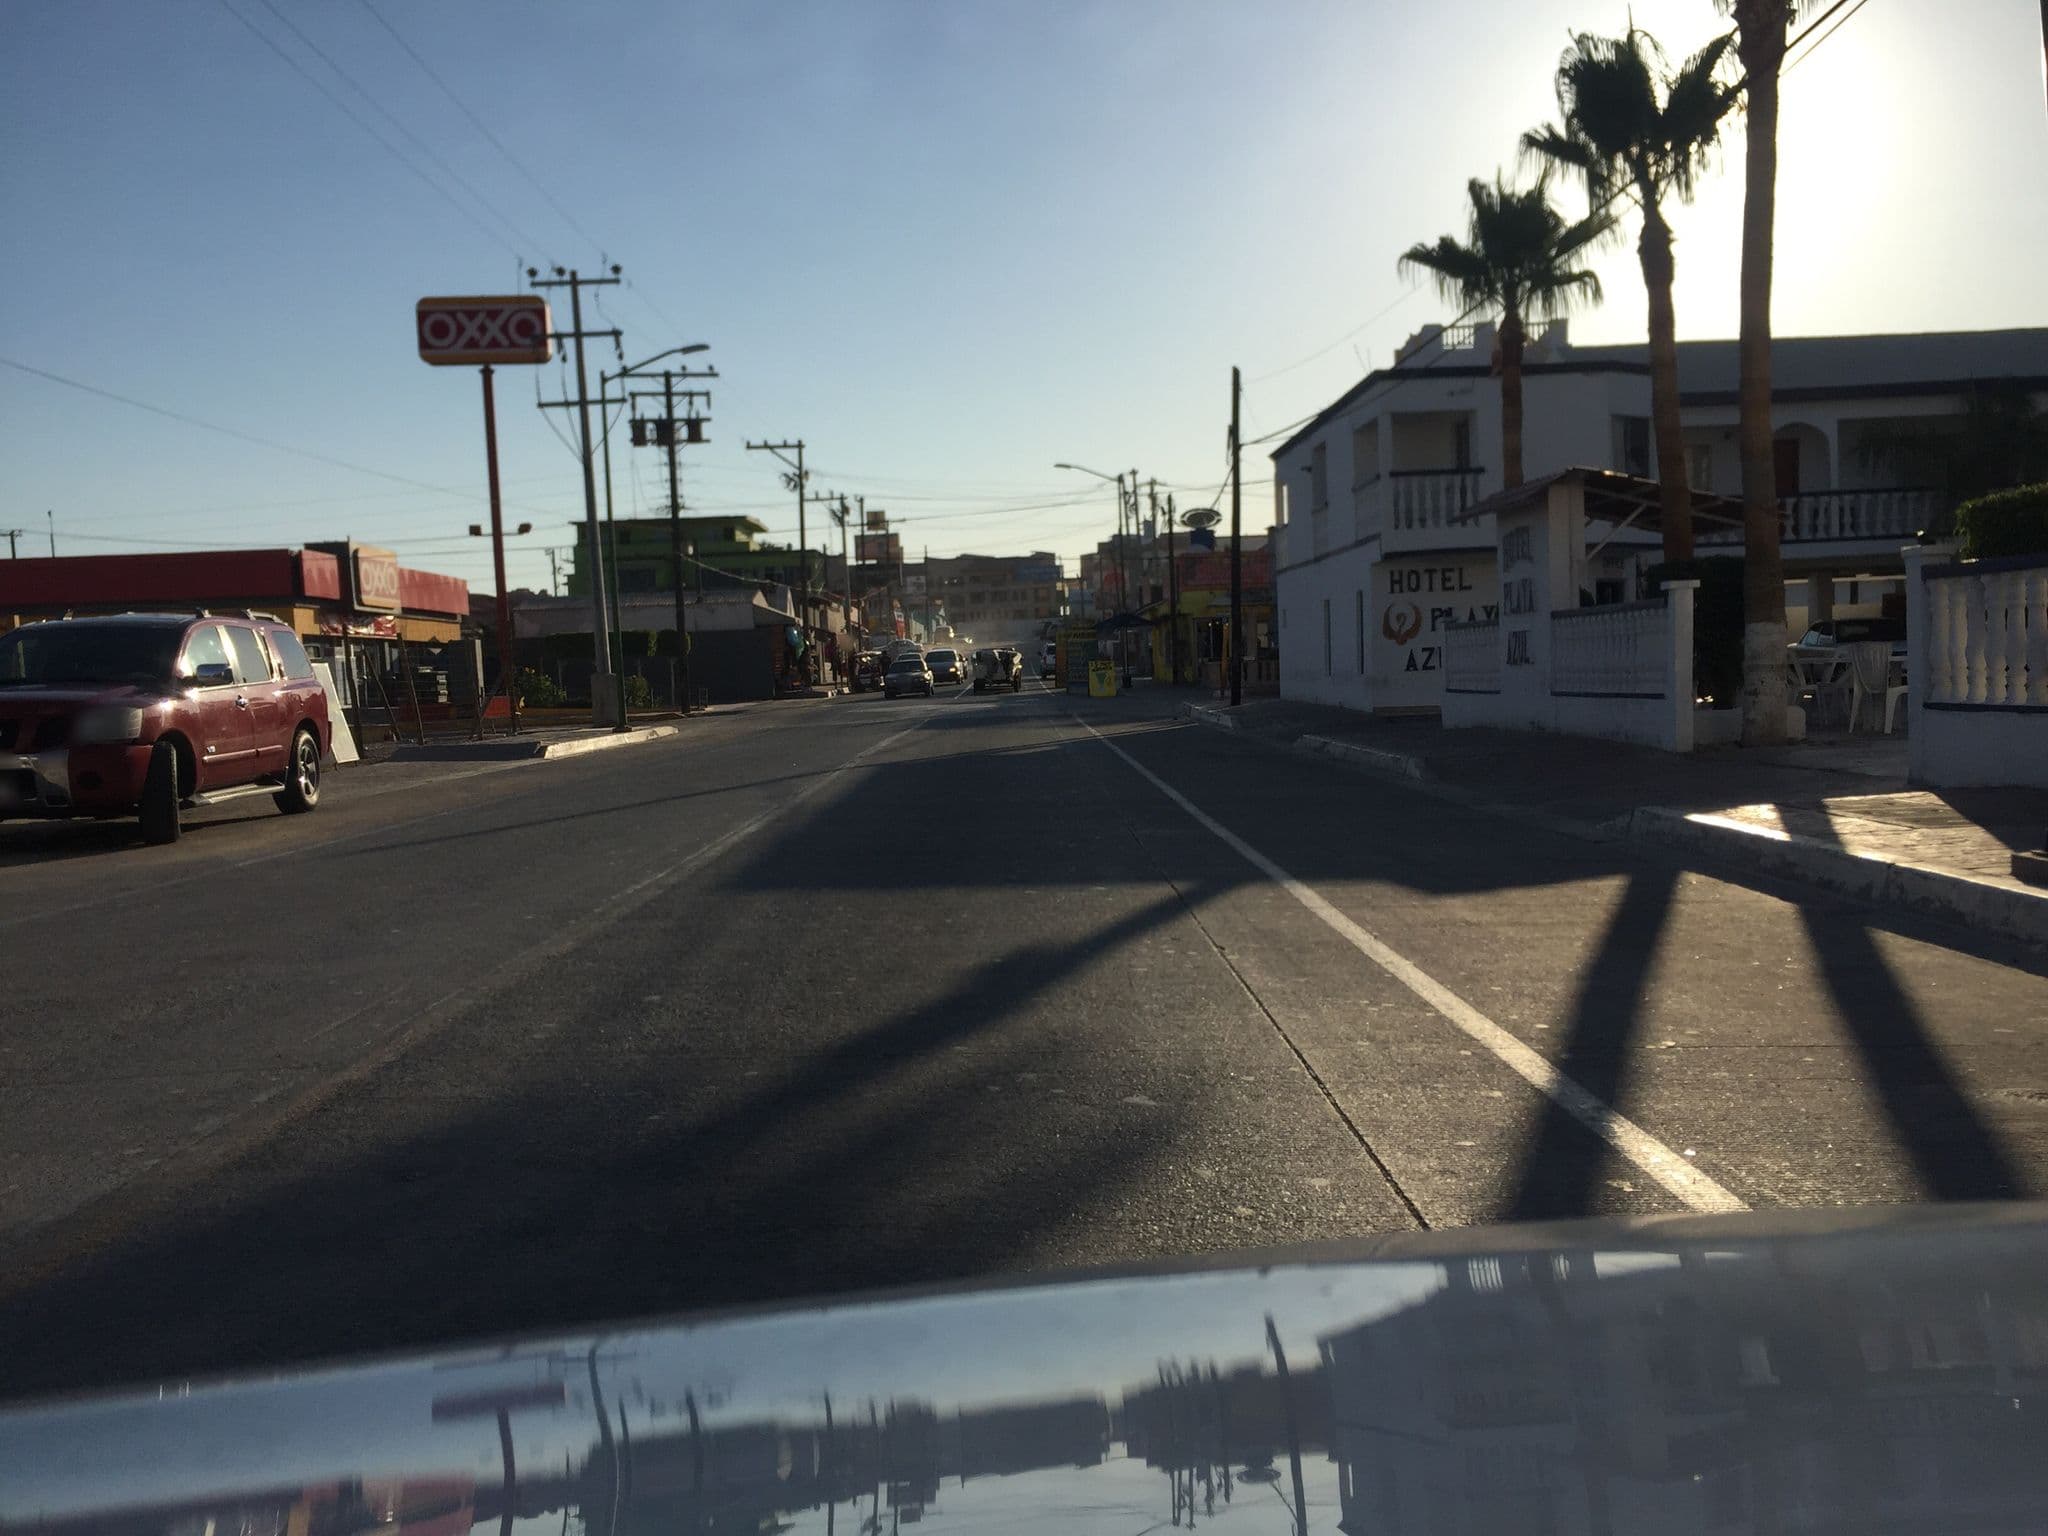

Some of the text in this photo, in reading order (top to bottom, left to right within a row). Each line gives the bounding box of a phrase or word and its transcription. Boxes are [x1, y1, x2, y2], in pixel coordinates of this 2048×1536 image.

[423, 309, 542, 353] OXXO
[360, 559, 397, 595] OXXO
[1389, 567, 1472, 593] HOTEL
[1431, 602, 1499, 632] PLAY
